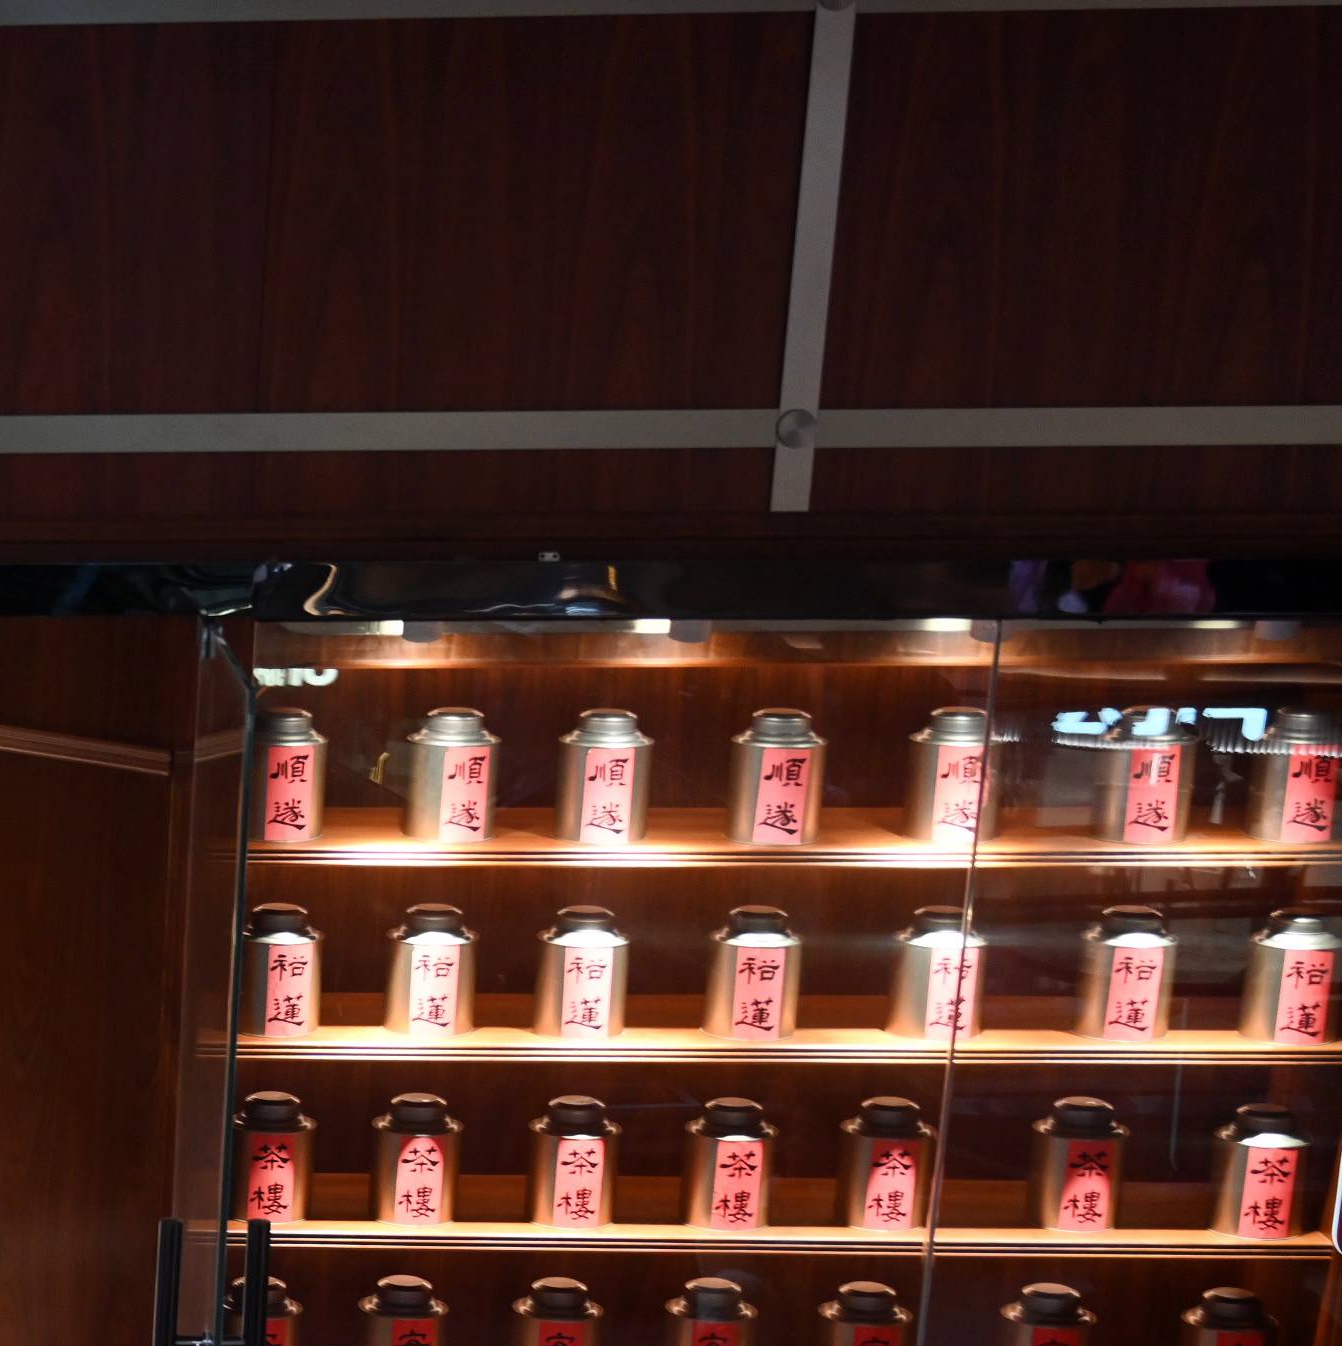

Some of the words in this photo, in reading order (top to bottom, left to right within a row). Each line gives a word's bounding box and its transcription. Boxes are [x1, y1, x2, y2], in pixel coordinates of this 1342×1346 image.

[268, 754, 310, 831] 順遂
[448, 755, 490, 832] 順遂
[586, 756, 629, 834] 順遂
[762, 757, 807, 834] 順遂
[267, 954, 309, 1027] 裕蓮
[412, 954, 454, 1028] 裕蓮
[565, 956, 608, 1028] 裕蓮
[734, 956, 781, 1031] 裕蓮
[1108, 956, 1157, 1032] 裕蓮
[1281, 960, 1329, 1037] 裕蓮
[250, 1143, 291, 1214] 茶樓
[398, 1145, 439, 1219] 茶樓
[557, 1148, 599, 1221] 茶樓
[713, 1150, 758, 1224] 茶樓
[867, 1149, 913, 1223] 茶樓
[1061, 1150, 1109, 1224] 茶樓
[1244, 1156, 1290, 1232] 茶樓
